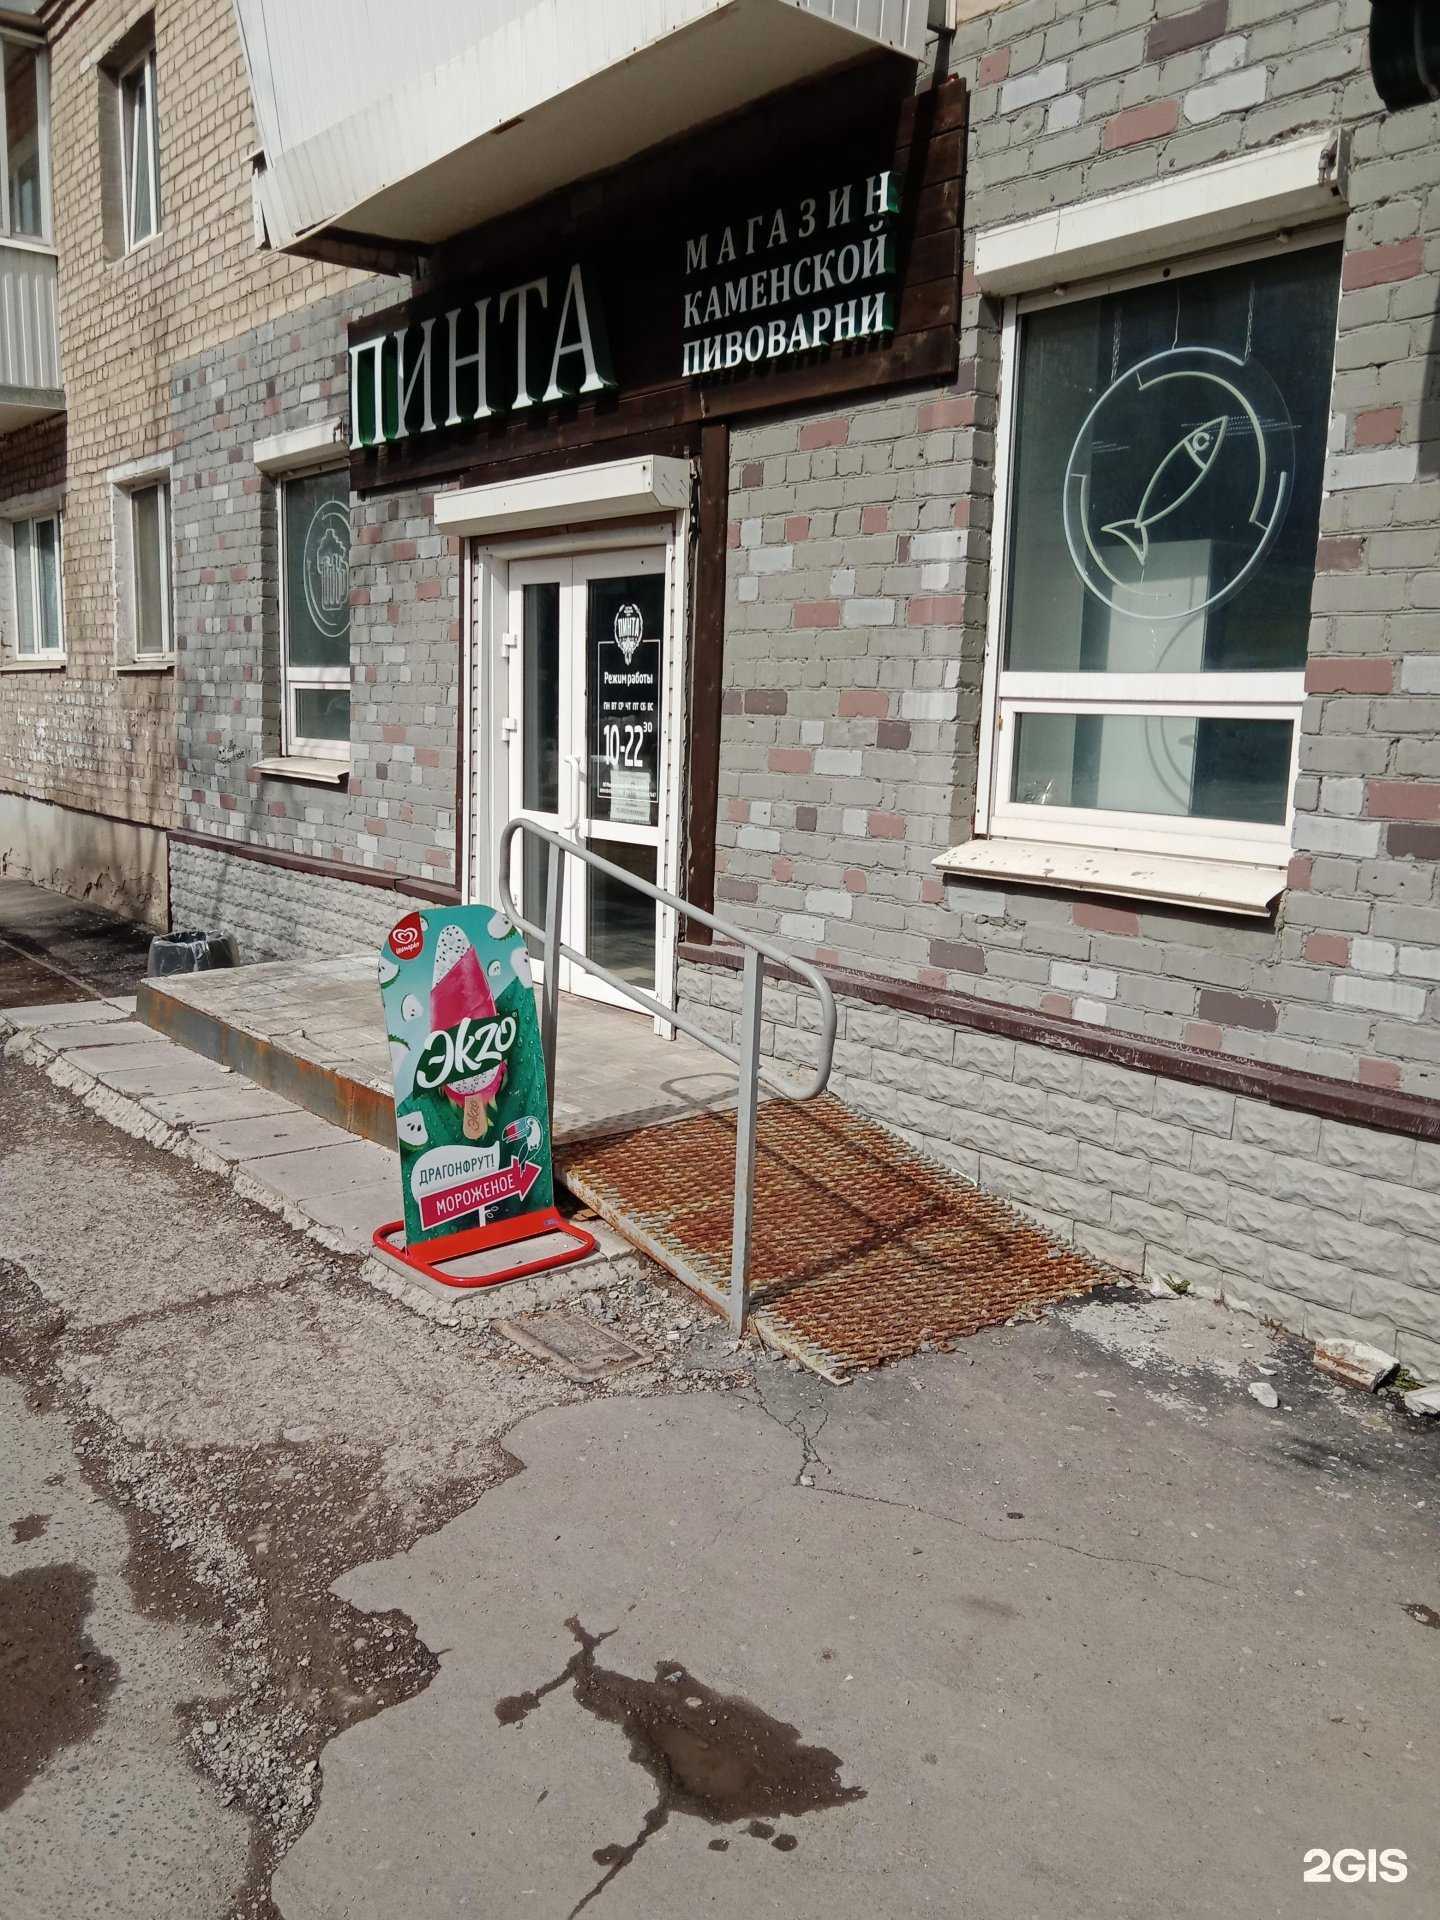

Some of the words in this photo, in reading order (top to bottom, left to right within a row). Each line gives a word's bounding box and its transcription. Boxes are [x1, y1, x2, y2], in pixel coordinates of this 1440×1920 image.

[685, 170, 891, 275] МАГАЗИН
[683, 219, 888, 329] КАМЕНСКОЙ
[349, 263, 604, 450] ПИНТА
[681, 291, 887, 377] ПИВОВАРНИ
[617, 616, 640, 638] ПИНТА
[603, 671, 627, 684] Режим
[627, 671, 654, 687] работы
[419, 1153, 495, 1187] ДРАГОНФРУТ!
[435, 1173, 515, 1216] МОРОЖЕНОЕ
